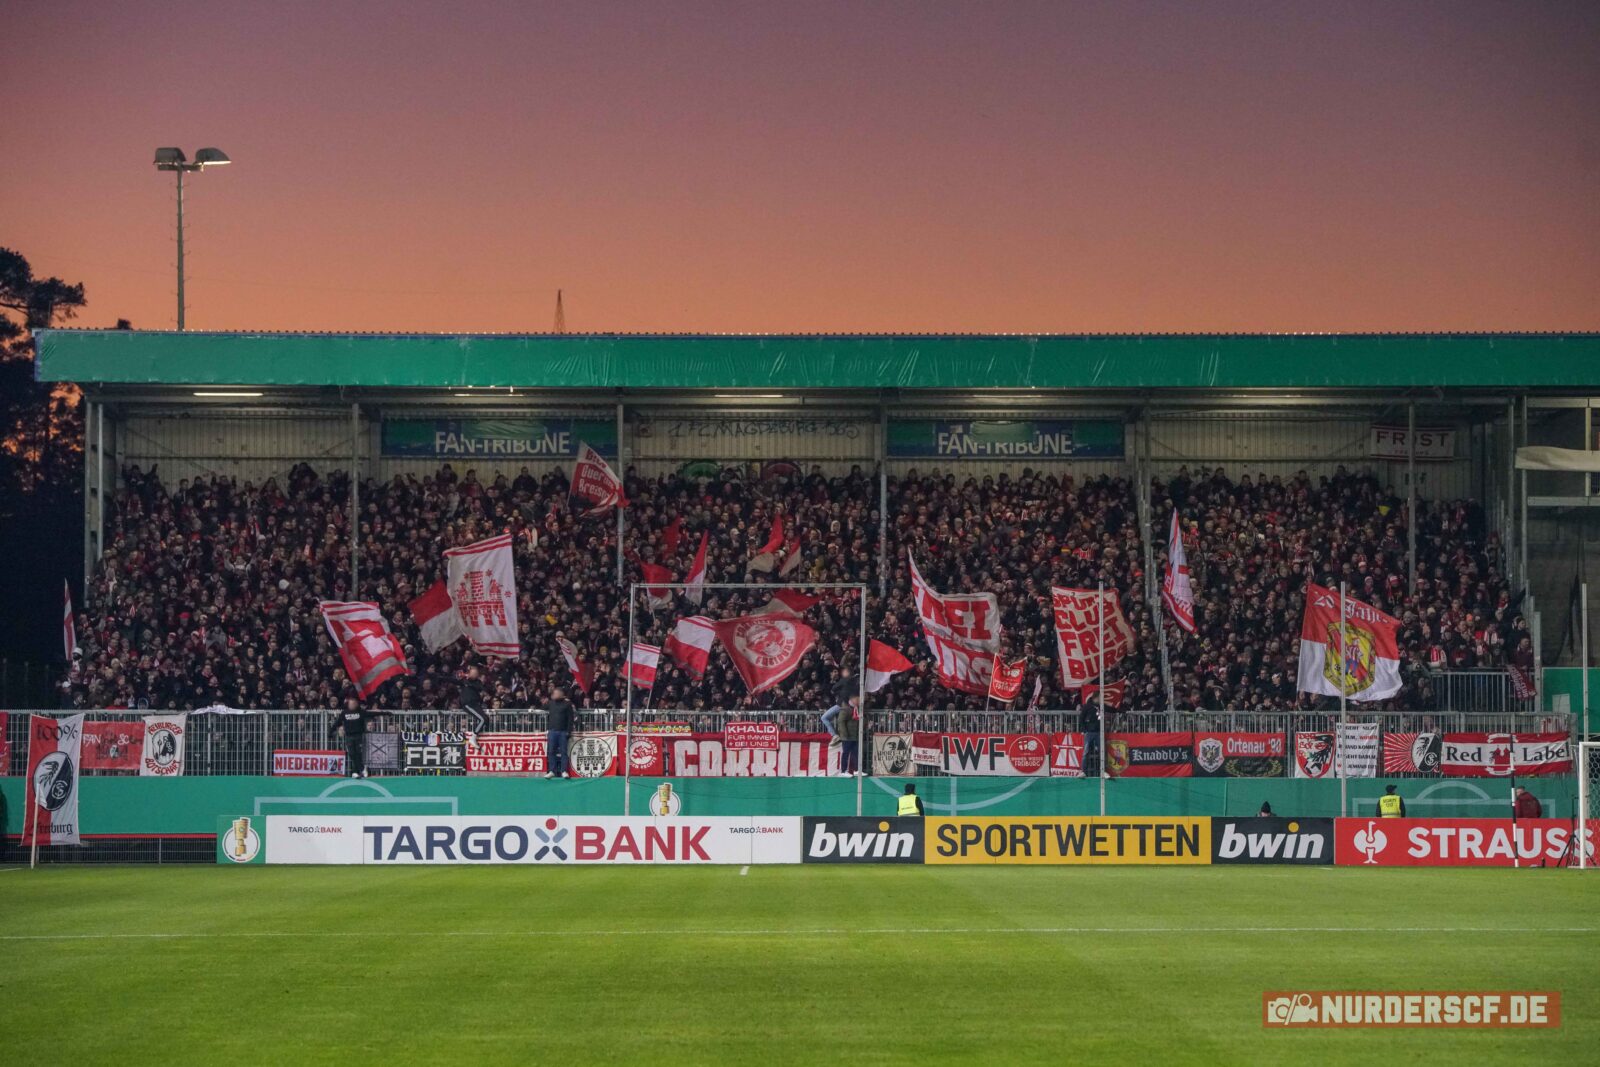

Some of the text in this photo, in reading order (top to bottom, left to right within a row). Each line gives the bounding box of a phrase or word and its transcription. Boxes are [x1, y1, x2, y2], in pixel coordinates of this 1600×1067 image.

[1376, 431, 1448, 447] FRST
[1056, 600, 1116, 631] CLUB
[1060, 617, 1127, 657] FREI
[1069, 641, 1128, 680] BURG
[37, 723, 78, 741] 100%
[727, 725, 776, 734] KHALID
[467, 742, 545, 756] SYNTHESIA
[941, 736, 1006, 771] IWF
[1227, 737, 1265, 754] Ortenau
[1445, 742, 1570, 762] Red Label
[145, 758, 181, 774] BOTSCHAFT
[470, 759, 543, 771] ULTRAS 79
[288, 826, 342, 834] TARGO BANK
[761, 826, 784, 834] BANK
[809, 821, 916, 858] bwin
[1218, 821, 1325, 859] bwin
[364, 825, 712, 861] TARGO BANK
[936, 823, 1200, 858] SPORTWETTEN
[1408, 826, 1595, 859] STRAUSS
